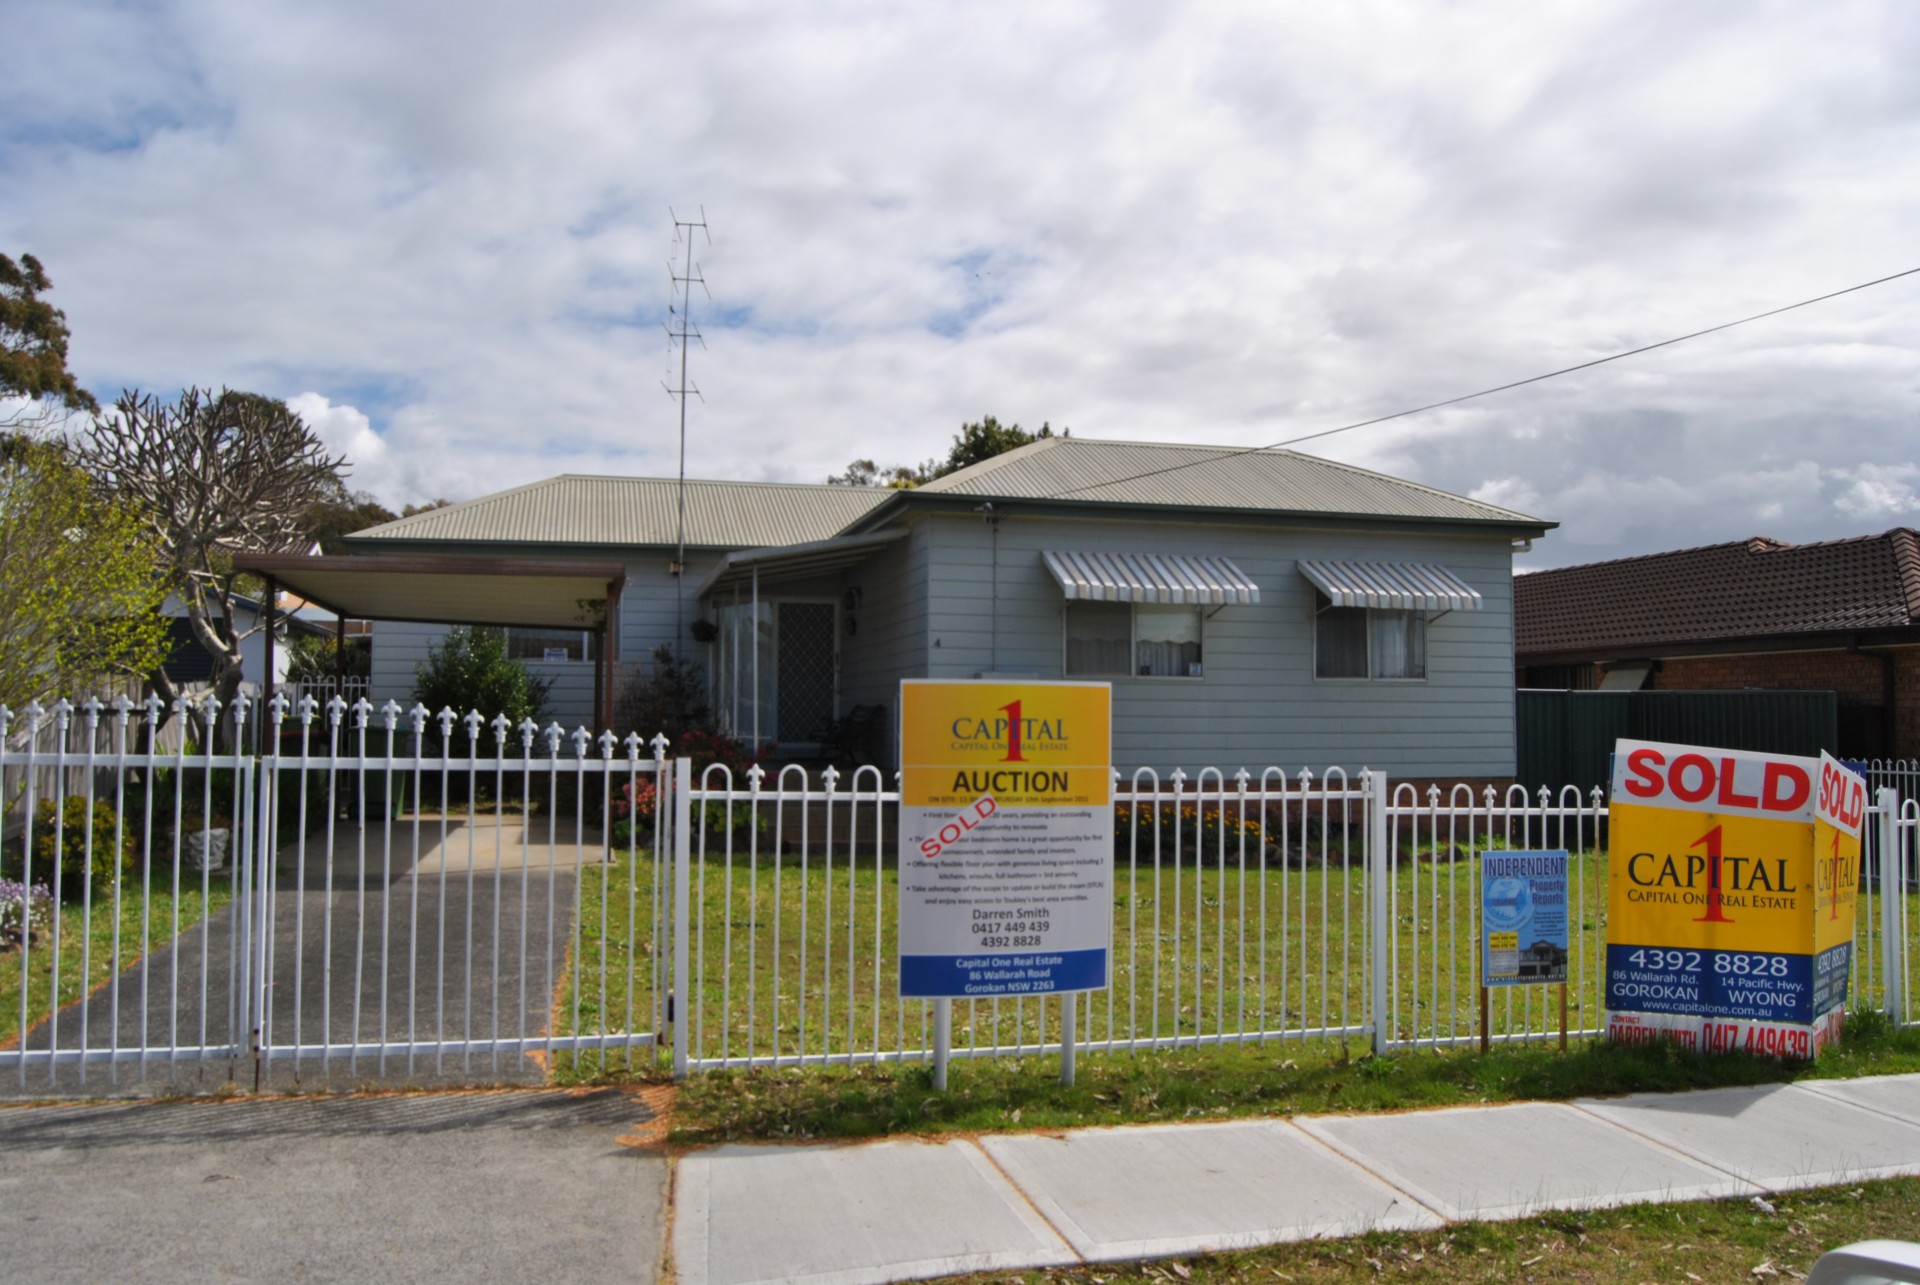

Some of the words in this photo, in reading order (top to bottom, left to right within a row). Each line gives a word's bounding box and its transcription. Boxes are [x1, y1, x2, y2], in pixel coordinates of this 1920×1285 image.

[951, 717, 1069, 741] CAPITAL
[952, 771, 1069, 793] AUCTION
[1624, 748, 1811, 812] SOLD
[1819, 761, 1863, 830] SOLD
[921, 797, 996, 858] SOLD
[1484, 857, 1565, 876] INDEPENDENT
[1627, 852, 1796, 893] CAPITAL
[1817, 856, 1855, 892] CAPITAL
[1529, 879, 1565, 892] Property
[1532, 892, 1564, 905] Reports
[1627, 889, 1678, 903] CAPITAL
[1683, 890, 1712, 905] ONE
[1716, 895, 1748, 908] REAL
[1752, 897, 1796, 909] ESTATE
[972, 909, 1013, 920] Darren
[1016, 907, 1050, 919] Smith
[972, 922, 1001, 934] 0417
[1004, 921, 1026, 932] 449
[1028, 921, 1050, 932] 439
[981, 936, 1010, 948] 4392
[1013, 935, 1041, 947] 8828
[956, 958, 990, 969] Capital
[991, 957, 1012, 968] One
[1013, 957, 1034, 967] Real
[1035, 956, 1063, 965] Estate
[1629, 949, 1702, 971] 4392
[1713, 953, 1788, 977] 8828
[969, 970, 982, 981] 86
[983, 970, 1026, 980] Wallarah
[1027, 968, 1051, 978] Road
[1613, 970, 1627, 980] 86
[1630, 972, 1677, 983] Wallarah
[1680, 974, 1699, 985] Rd.
[964, 983, 1006, 994] Gorokan
[1007, 982, 1031, 992] NSW
[1032, 980, 1055, 990] 2263
[1613, 983, 1698, 1001] GOROKAN
[1721, 977, 1735, 987] 14
[1738, 978, 1774, 989] Pacific
[1777, 981, 1804, 992] Hwy.
[1728, 989, 1796, 1007] WYONG
[1642, 1001, 1772, 1017] www.capitalone.com.au
[1612, 1015, 1640, 1024] CONTACT
[1702, 1023, 1739, 1056] 0417
[1744, 1026, 1808, 1059] 449439
